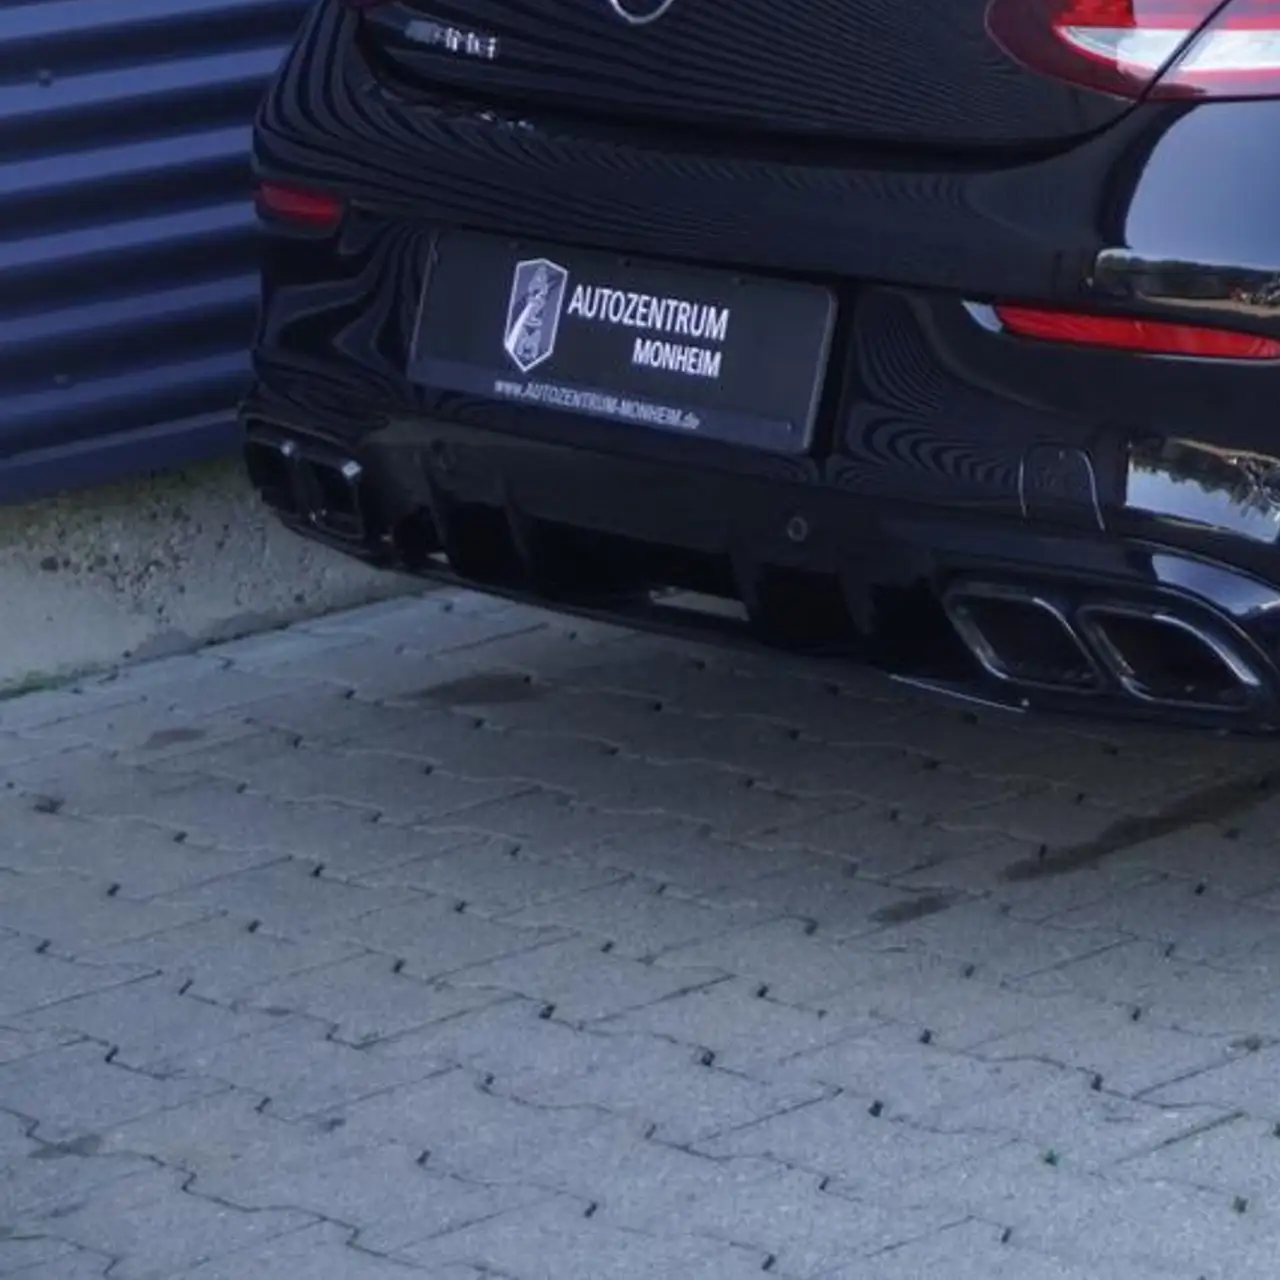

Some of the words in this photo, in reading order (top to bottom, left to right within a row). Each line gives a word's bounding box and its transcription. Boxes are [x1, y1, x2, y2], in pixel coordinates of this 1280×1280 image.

[567, 283, 730, 341] AUTOZENTRUM
[632, 337, 722, 378] MONHEIM
[494, 379, 700, 429] www.AUTOZENTRUM-MONHEIM.de
